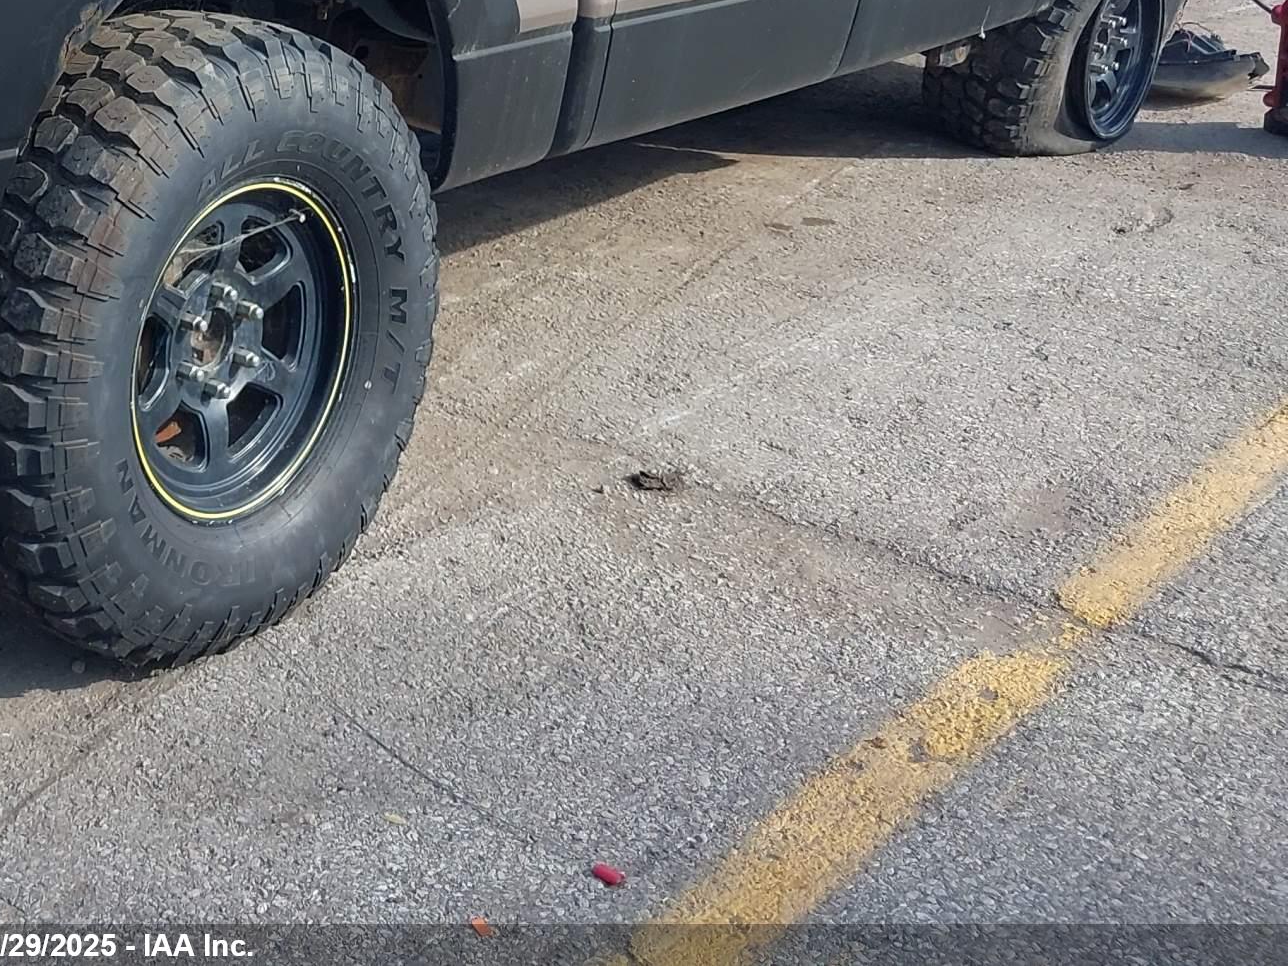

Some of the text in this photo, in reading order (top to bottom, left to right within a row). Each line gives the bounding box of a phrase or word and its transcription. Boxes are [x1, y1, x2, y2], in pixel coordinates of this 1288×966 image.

[196, 129, 409, 396] ALL COUNTRY M/T
[114, 457, 258, 587] IRONMAN
